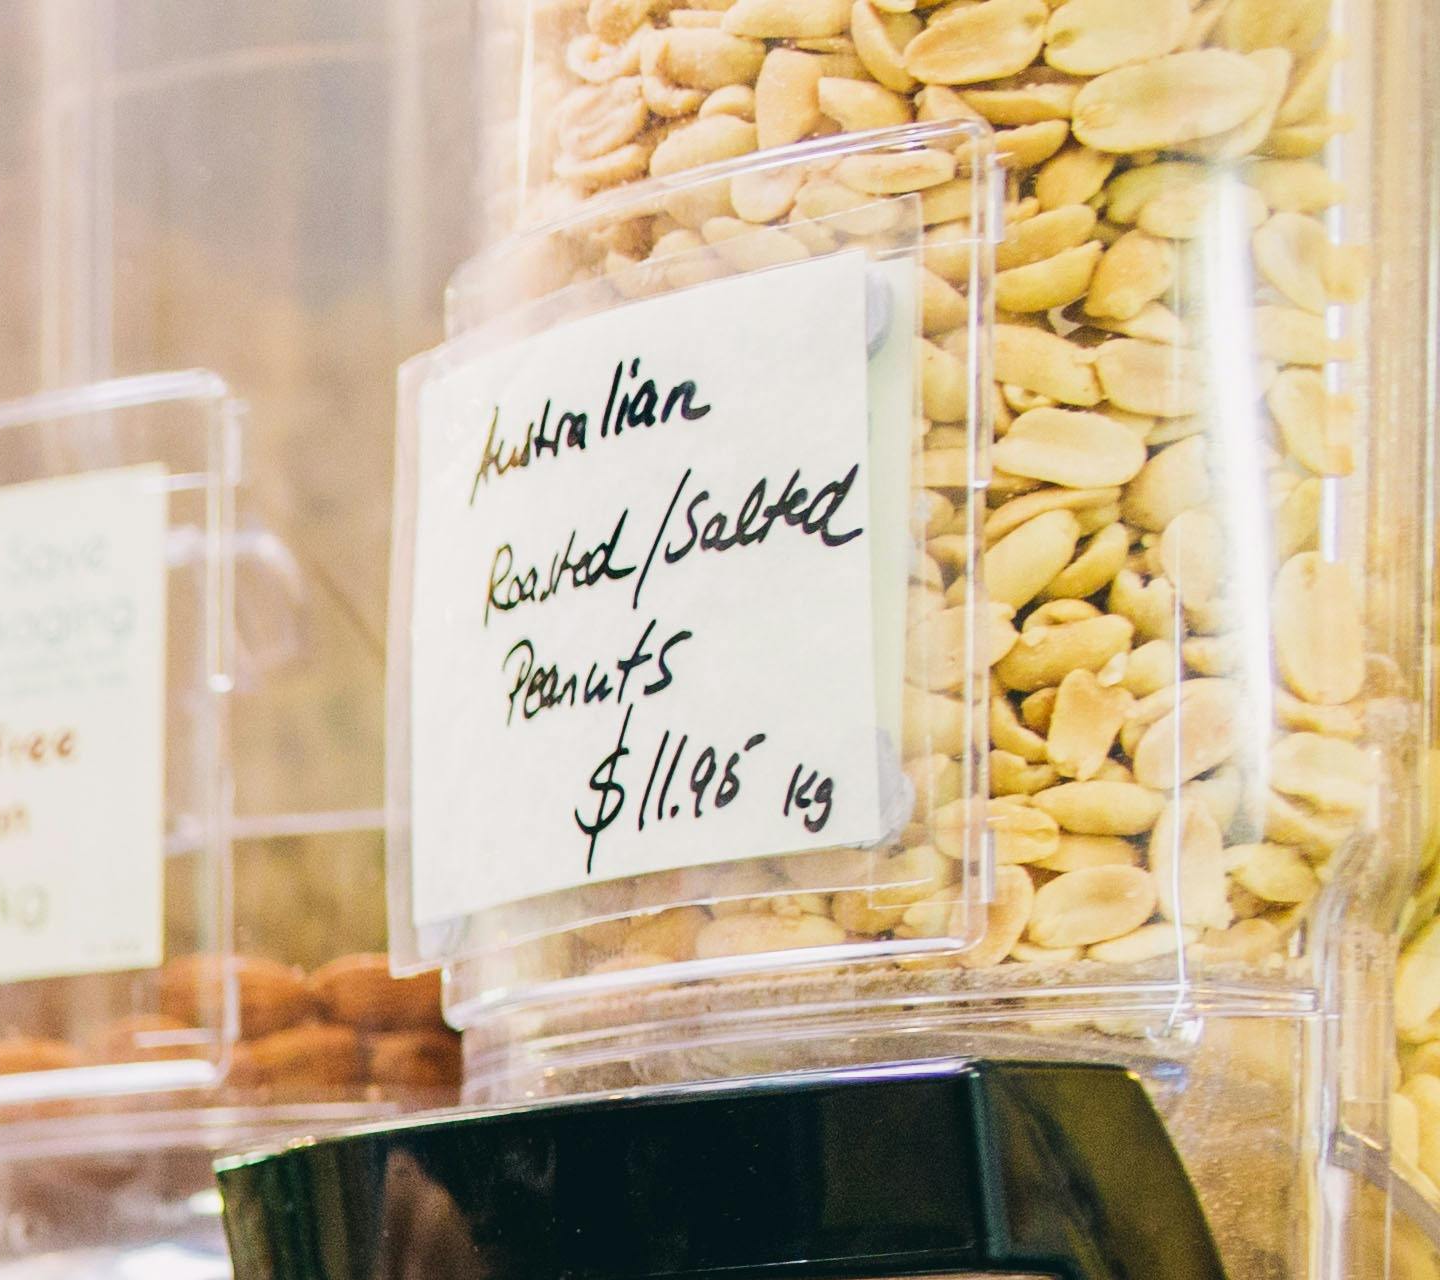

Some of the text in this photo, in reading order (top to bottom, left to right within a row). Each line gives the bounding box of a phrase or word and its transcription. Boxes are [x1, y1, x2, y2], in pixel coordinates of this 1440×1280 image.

[470, 357, 712, 506] Australian
[502, 618, 694, 728] Peanuts
[574, 702, 768, 876] $11.95
